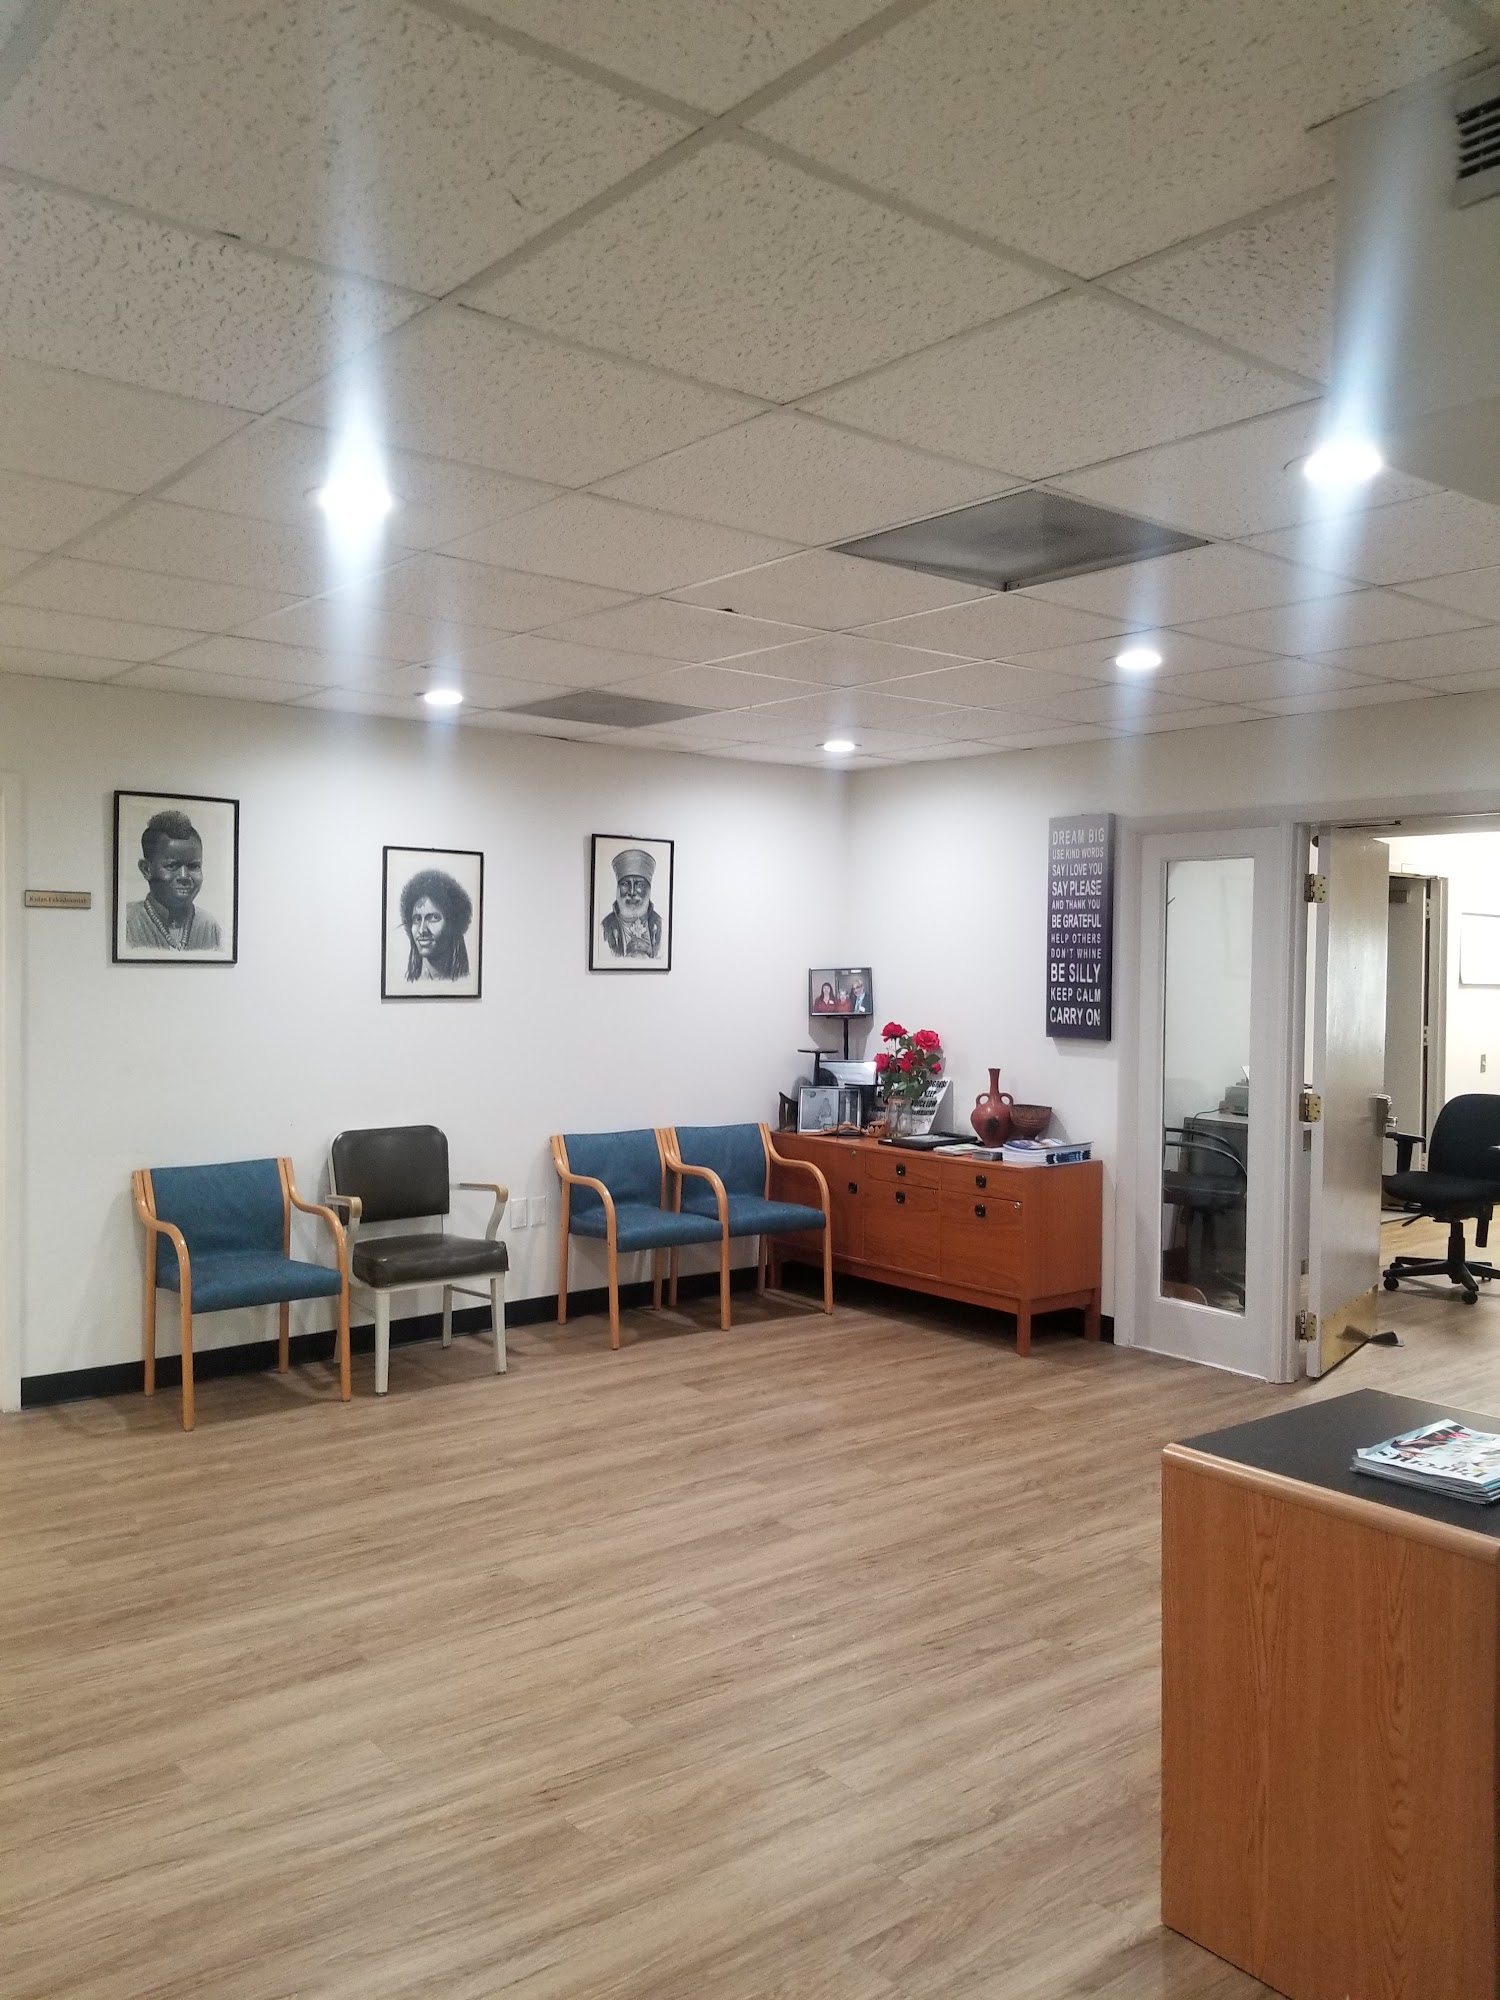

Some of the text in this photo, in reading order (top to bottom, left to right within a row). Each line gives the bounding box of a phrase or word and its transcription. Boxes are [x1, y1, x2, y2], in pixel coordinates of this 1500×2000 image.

[1053, 828, 1104, 845] DREAM BIG
[1053, 847, 1103, 859] USE KIND WORDS
[1052, 863, 1102, 876] SAY I LOVE YOU
[1052, 880, 1102, 896] SAY PLEASE
[1052, 899, 1100, 910] AND THANK YOU
[1052, 914, 1101, 928] BE GRATEFUL
[1051, 933, 1101, 943] HELP OTHERS
[1051, 948, 1101, 959] DON'T WHINE
[1051, 963, 1100, 983] BE SILLY
[1051, 987, 1100, 1002] KEEP CALM
[1050, 1006, 1100, 1026] CARRY ON
